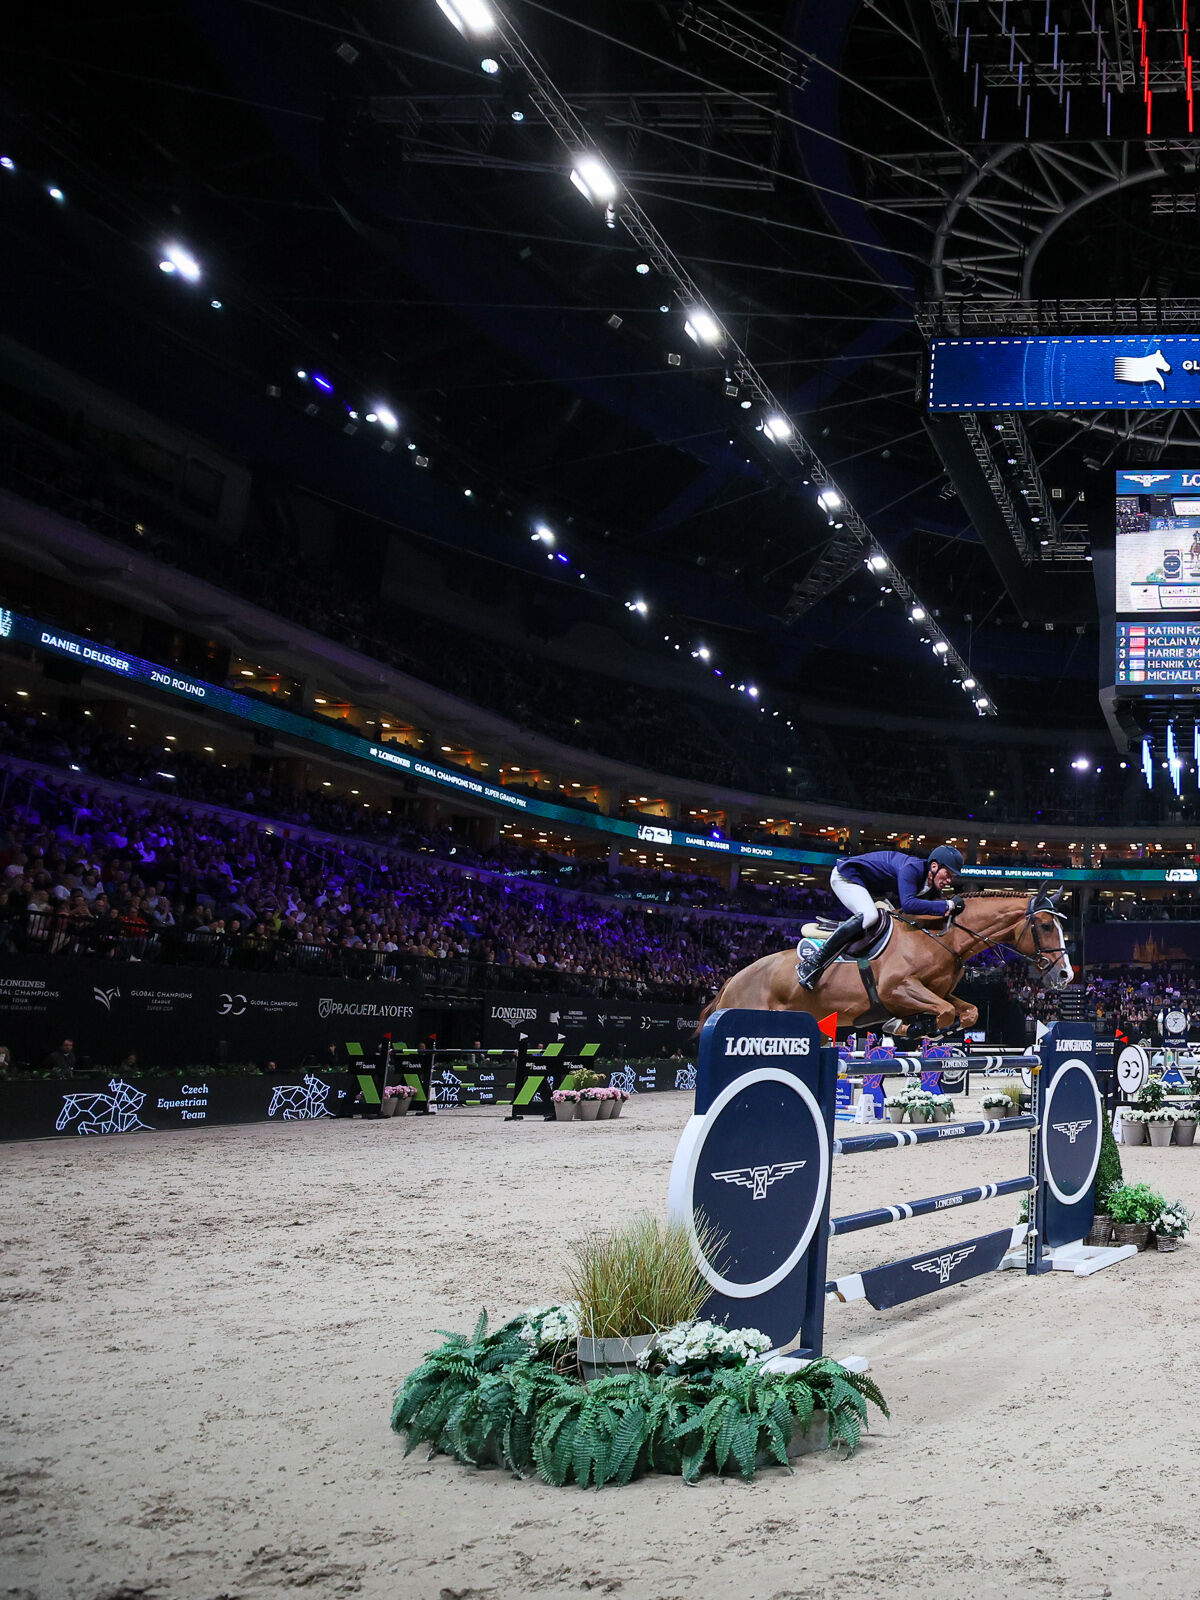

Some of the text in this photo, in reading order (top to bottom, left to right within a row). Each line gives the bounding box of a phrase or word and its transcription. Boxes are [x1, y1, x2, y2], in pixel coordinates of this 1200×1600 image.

[1120, 626, 1125, 636] 1
[1148, 626, 1185, 635] KATRIN
[1120, 638, 1126, 646] 2
[1148, 637, 1187, 646] MCLAIN
[1120, 649, 1126, 658] 3
[1148, 648, 1184, 657] HARRIE
[40, 632, 206, 697] DANIEL DEUSSER 2ND ROUND
[1119, 660, 1125, 669] 4
[1148, 660, 1184, 668] HENRIK
[1119, 672, 1125, 680] 5
[1148, 671, 1194, 680] MICHAEL
[414, 763, 436, 777] GLOBAL
[436, 771, 469, 789] CHAMPIONS
[469, 780, 482, 792] TOUR
[484, 788, 500, 799] SUPER
[500, 793, 516, 804] GRAND
[516, 798, 527, 808] PRIX
[686, 837, 706, 846] DANIEL
[706, 840, 730, 850] DEUSSER
[752, 848, 773, 856] ROUND
[14, 990, 59, 998] CHAMPIONS
[156, 991, 193, 999] CHAMPIONS
[491, 1006, 537, 1020] LONGINES
[725, 1036, 810, 1056] LONGINES
[1055, 1039, 1092, 1052] LONGINES
[941, 1060, 969, 1068] LONGINES
[480, 1074, 494, 1082] Czech
[181, 1084, 209, 1095] Czech
[157, 1096, 208, 1109] Equestrian
[181, 1109, 206, 1120] Team
[937, 1126, 965, 1138] LONGINES
[935, 1196, 963, 1209] LONGINES
